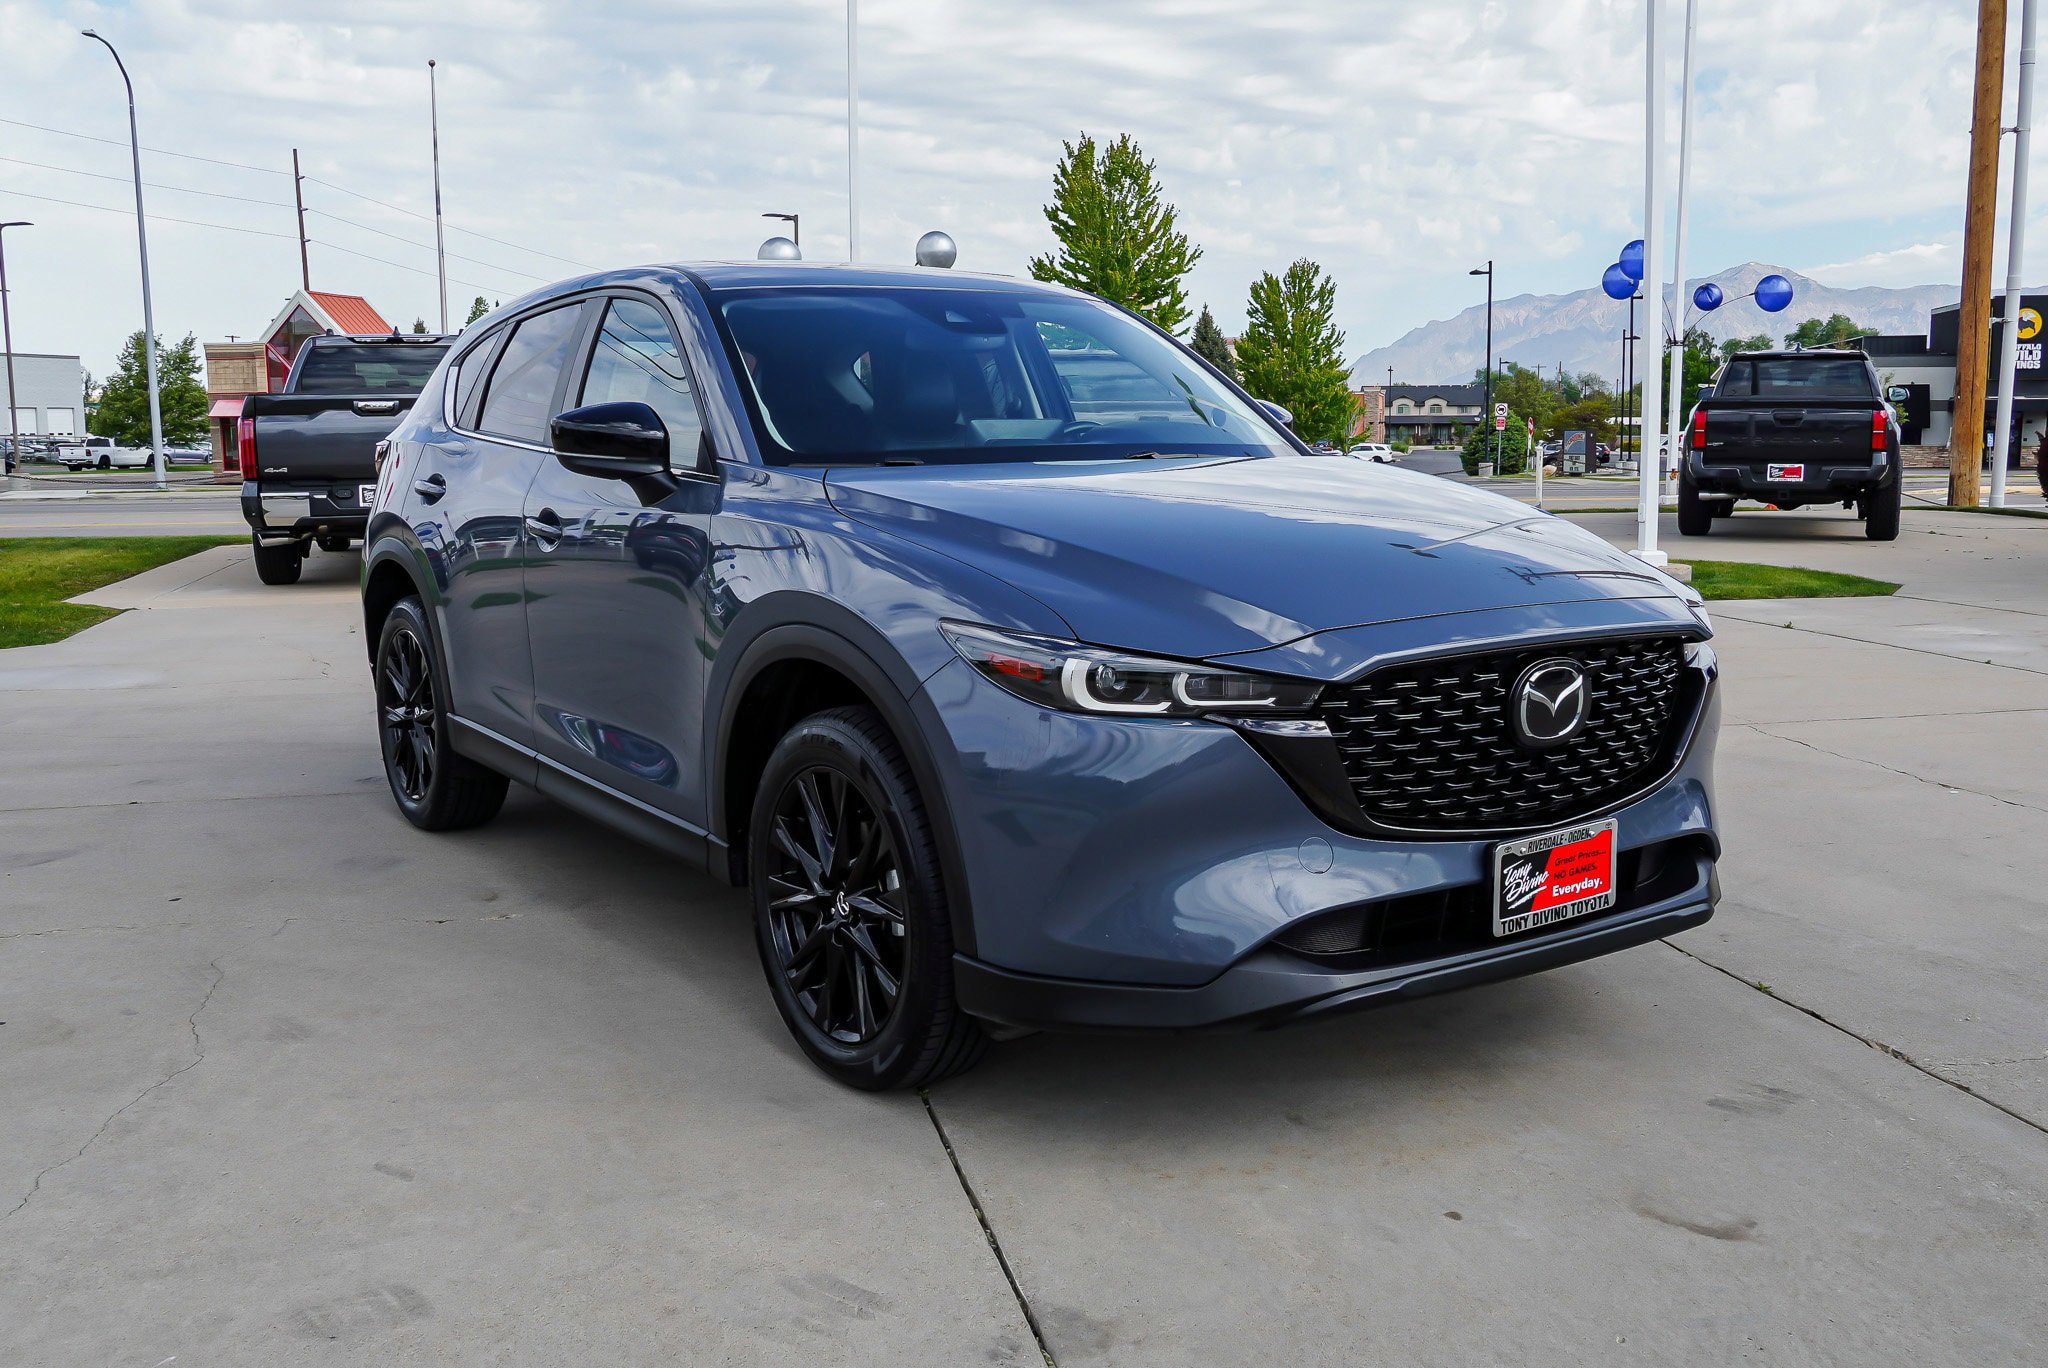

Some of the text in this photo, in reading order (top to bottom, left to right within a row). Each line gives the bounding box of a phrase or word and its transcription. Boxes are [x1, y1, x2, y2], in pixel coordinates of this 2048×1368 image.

[2015, 360, 2041, 369] INGS
[1528, 834, 1564, 853] RIVERDALE
[1569, 827, 1591, 844] OGDEN
[1553, 862, 1598, 880] NO GAMES.
[1554, 854, 1576, 867] Great
[1503, 859, 1533, 886] Tony
[1502, 871, 1550, 903] Divino
[1552, 877, 1603, 897] Everyday.
[1501, 894, 1610, 934] TONY DIVINO TOYOTA
